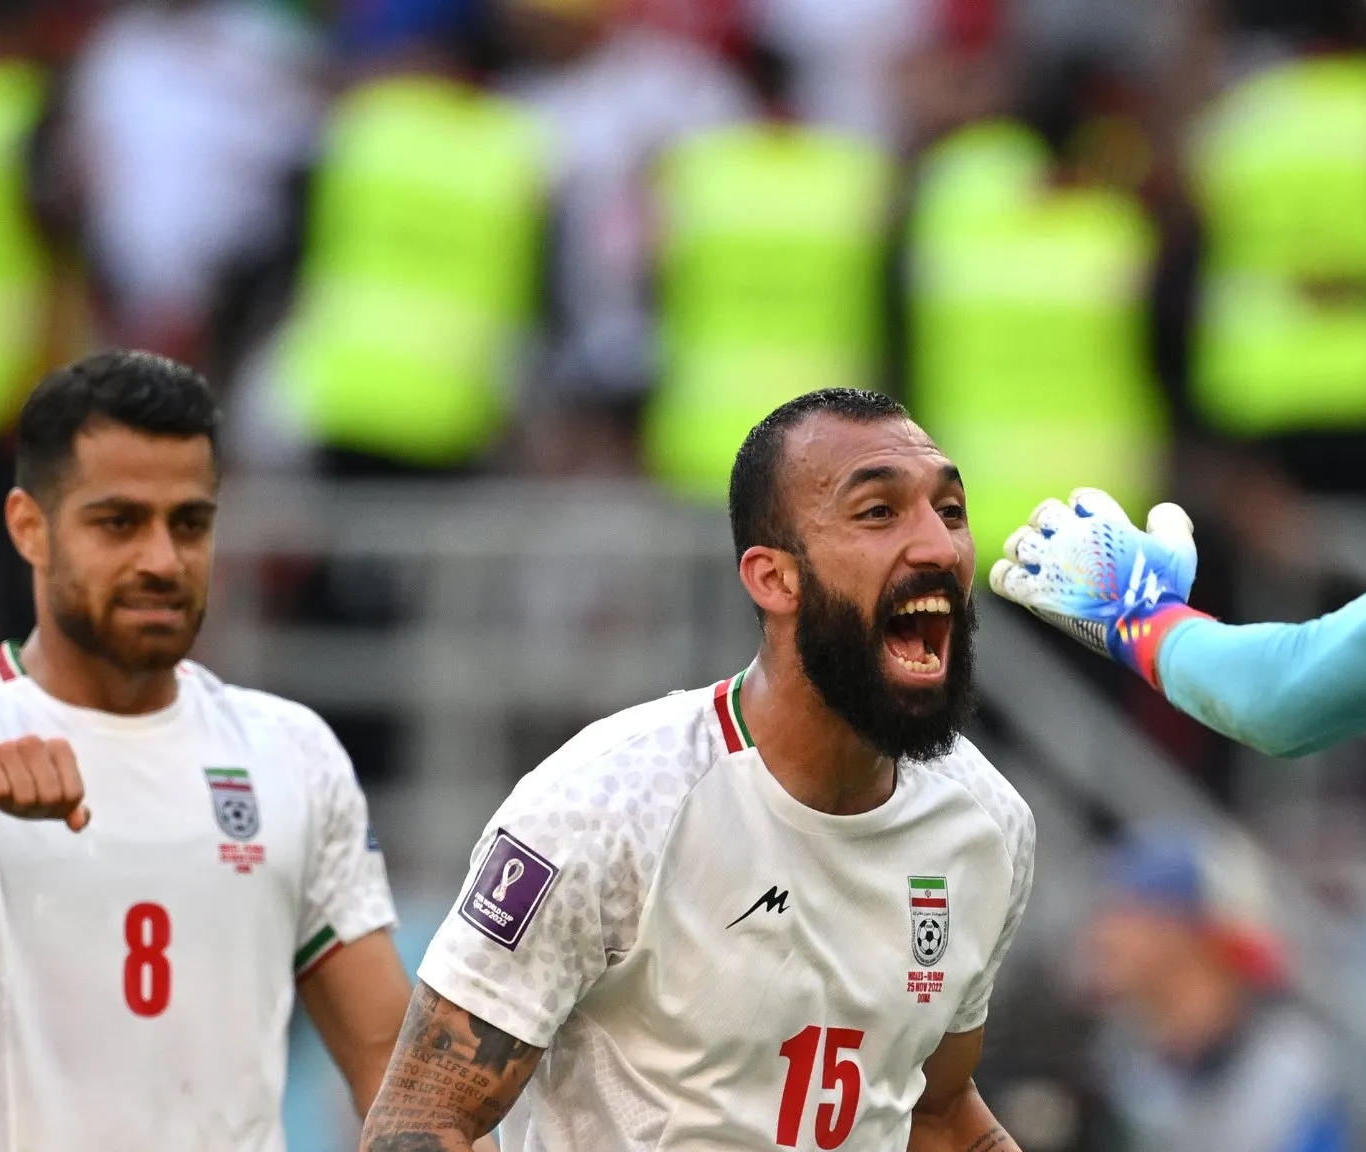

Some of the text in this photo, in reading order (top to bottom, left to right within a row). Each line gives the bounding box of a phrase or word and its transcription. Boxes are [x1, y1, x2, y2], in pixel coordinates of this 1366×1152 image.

[501, 911, 514, 922] CUP
[123, 901, 172, 1018] 8
[906, 982, 914, 992] 25
[928, 982, 942, 992] 2022
[776, 1024, 865, 1151] 15
